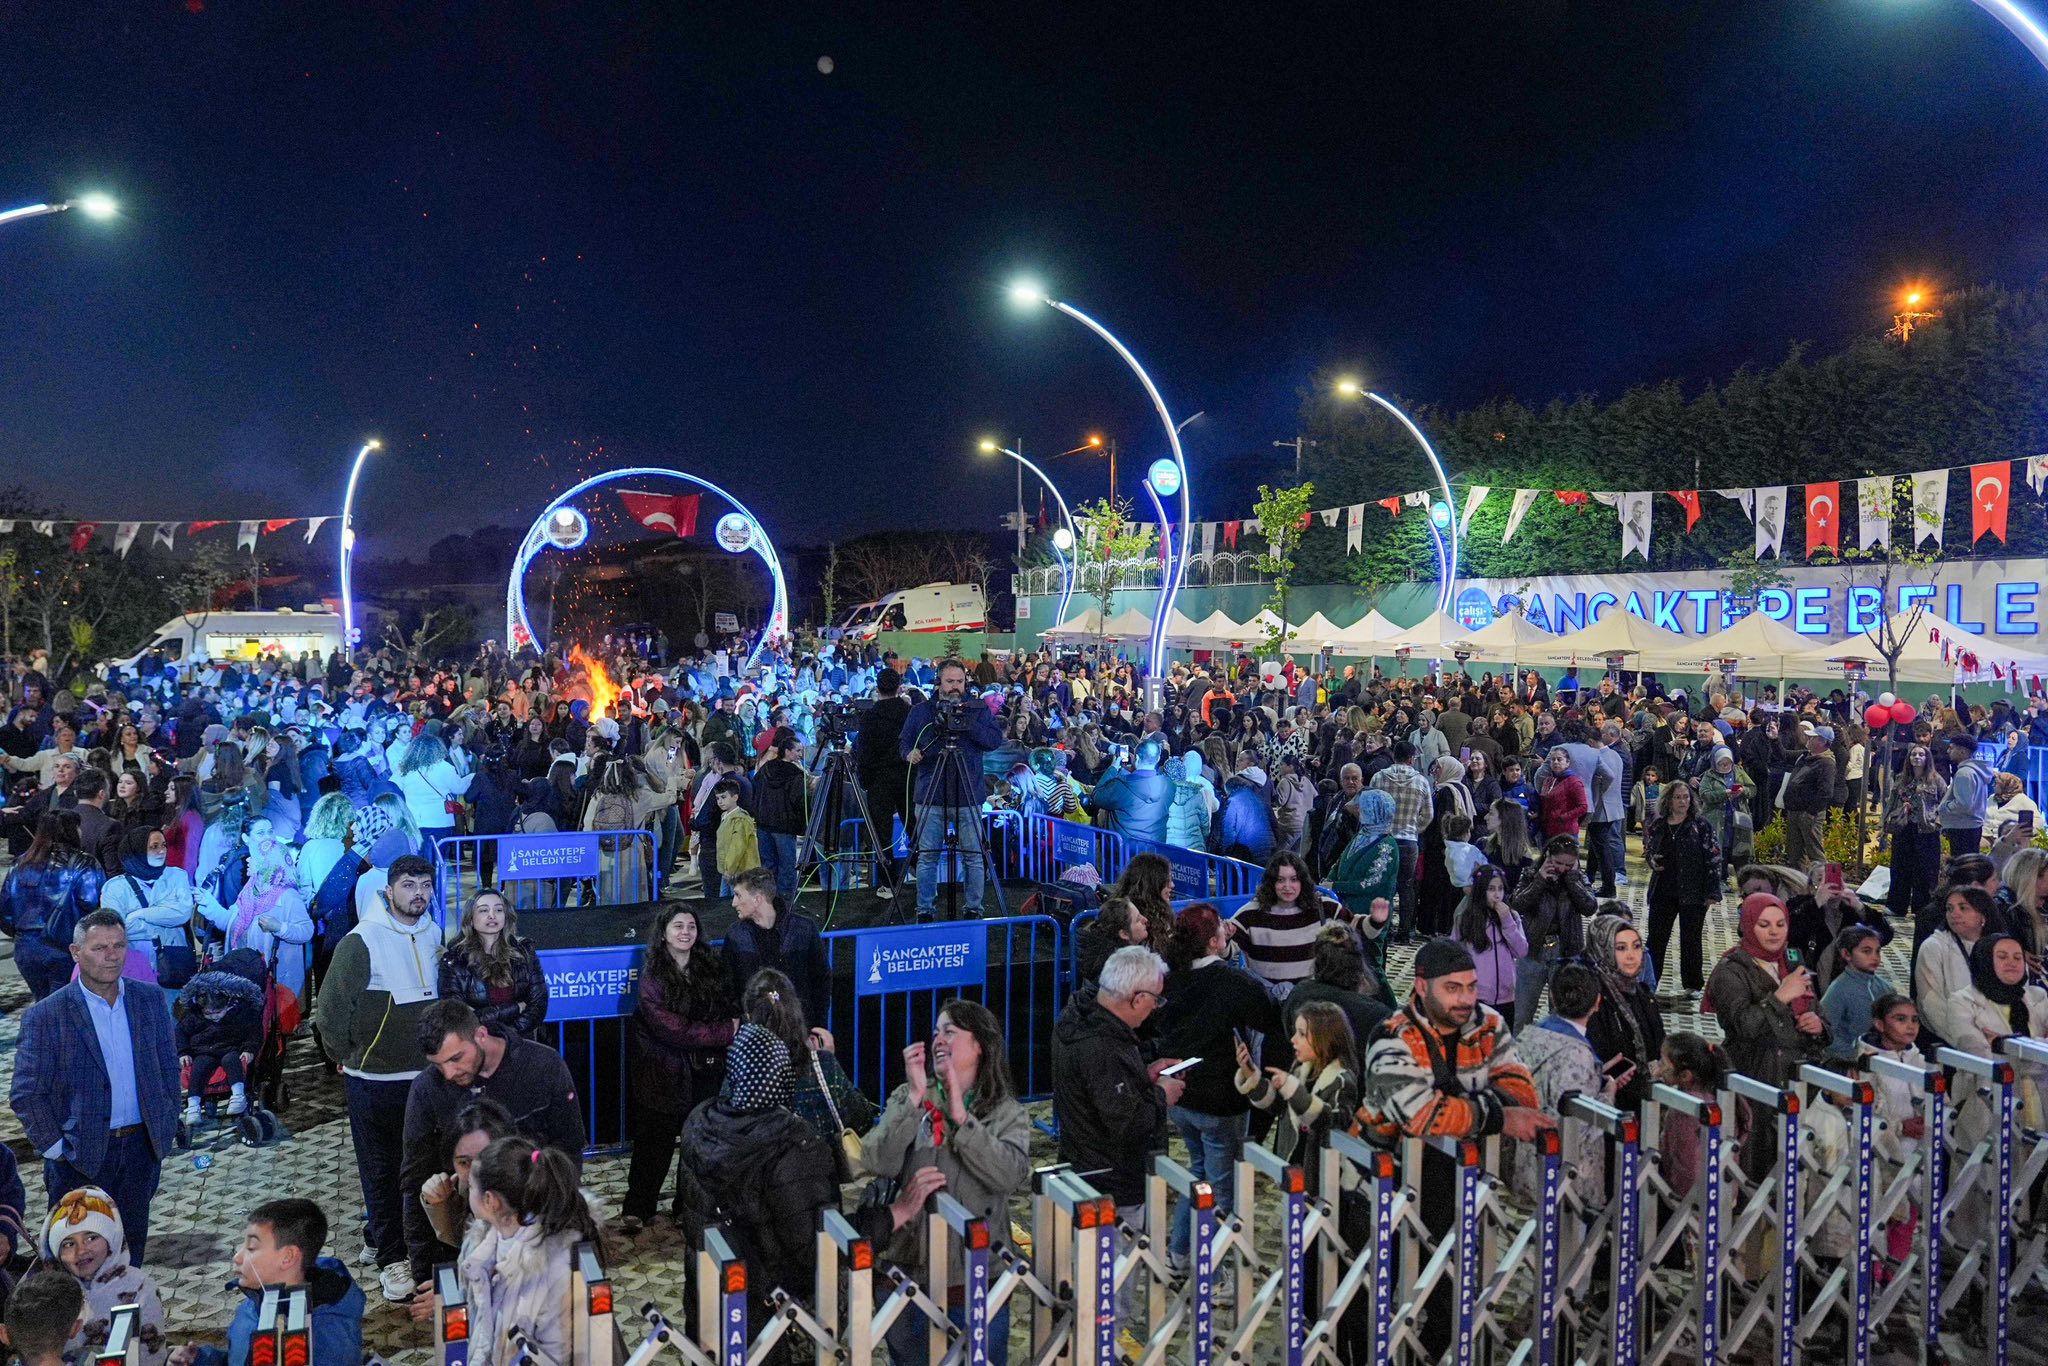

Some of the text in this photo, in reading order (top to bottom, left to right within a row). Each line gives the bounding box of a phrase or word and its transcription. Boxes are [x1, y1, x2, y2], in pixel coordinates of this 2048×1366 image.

[518, 846, 586, 858] SANCAKTEPE
[522, 855, 582, 867] BELEDİYESİ
[1169, 861, 1201, 878] ANCAKTEPE
[544, 968, 638, 985] ANCAKTEPE
[549, 981, 631, 998] ELEDİYESİ
[882, 943, 970, 961] SANCAKTEPE
[888, 955, 964, 973] BELEDİYESİ
[1620, 1153, 1632, 1285] SANCAKTEPE
[1706, 1138, 1718, 1302] SANCAKTEPE
[1860, 1116, 1870, 1273] SANCAKTEPE
[1929, 1101, 1942, 1336] SANCAKTEPE GÜVENLİK
[2000, 1096, 2010, 1247] SANCAKTEPE
[1291, 1204, 1300, 1349] SANCAKTEPE
[1377, 1192, 1389, 1366] SANCAKTEPE
[1462, 1176, 1474, 1315] SANCAKTEPE
[1542, 1168, 1556, 1339] SANCAKTEPE
[1783, 1123, 1796, 1365] SANCAKTEPE GÜVENLİK
[973, 1265, 985, 1362] SANCA
